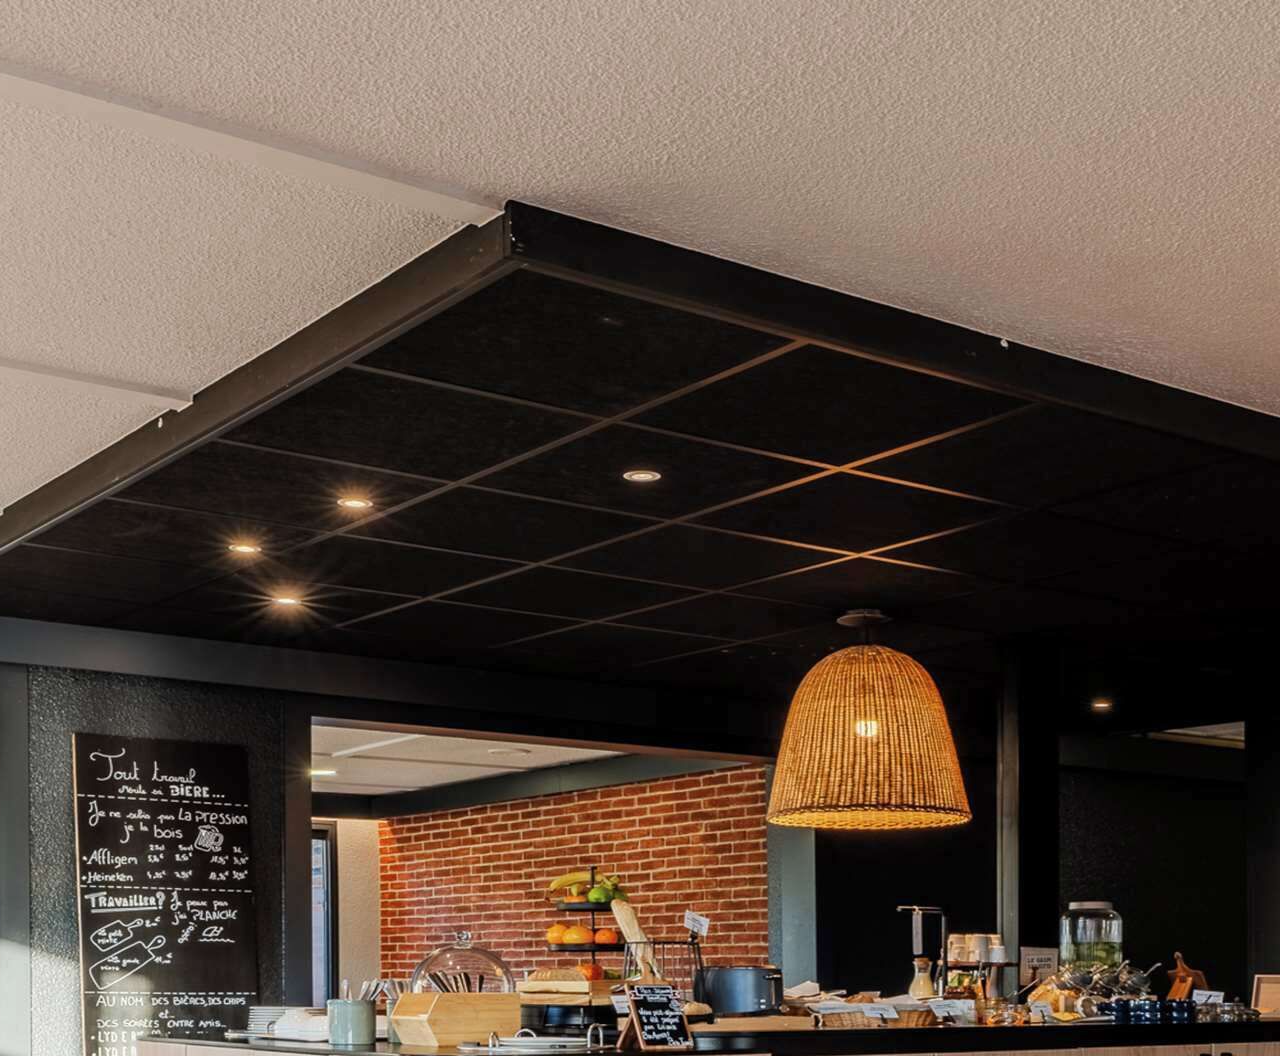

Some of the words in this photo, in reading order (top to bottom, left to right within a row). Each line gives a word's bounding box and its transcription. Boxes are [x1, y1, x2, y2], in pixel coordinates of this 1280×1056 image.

[89, 747, 140, 782] Tout
[151, 760, 197, 784] travail
[88, 800, 106, 827] Je
[108, 810, 123, 819] ne
[119, 821, 136, 844] je
[139, 821, 150, 832] la
[153, 824, 184, 840] bois
[87, 870, 134, 884] Heineken
[192, 909, 238, 922] PLANCHE
[95, 995, 117, 1008] AU
[120, 996, 145, 1007] NOM
[151, 997, 170, 1006] DES
[96, 1019, 119, 1029] DES
